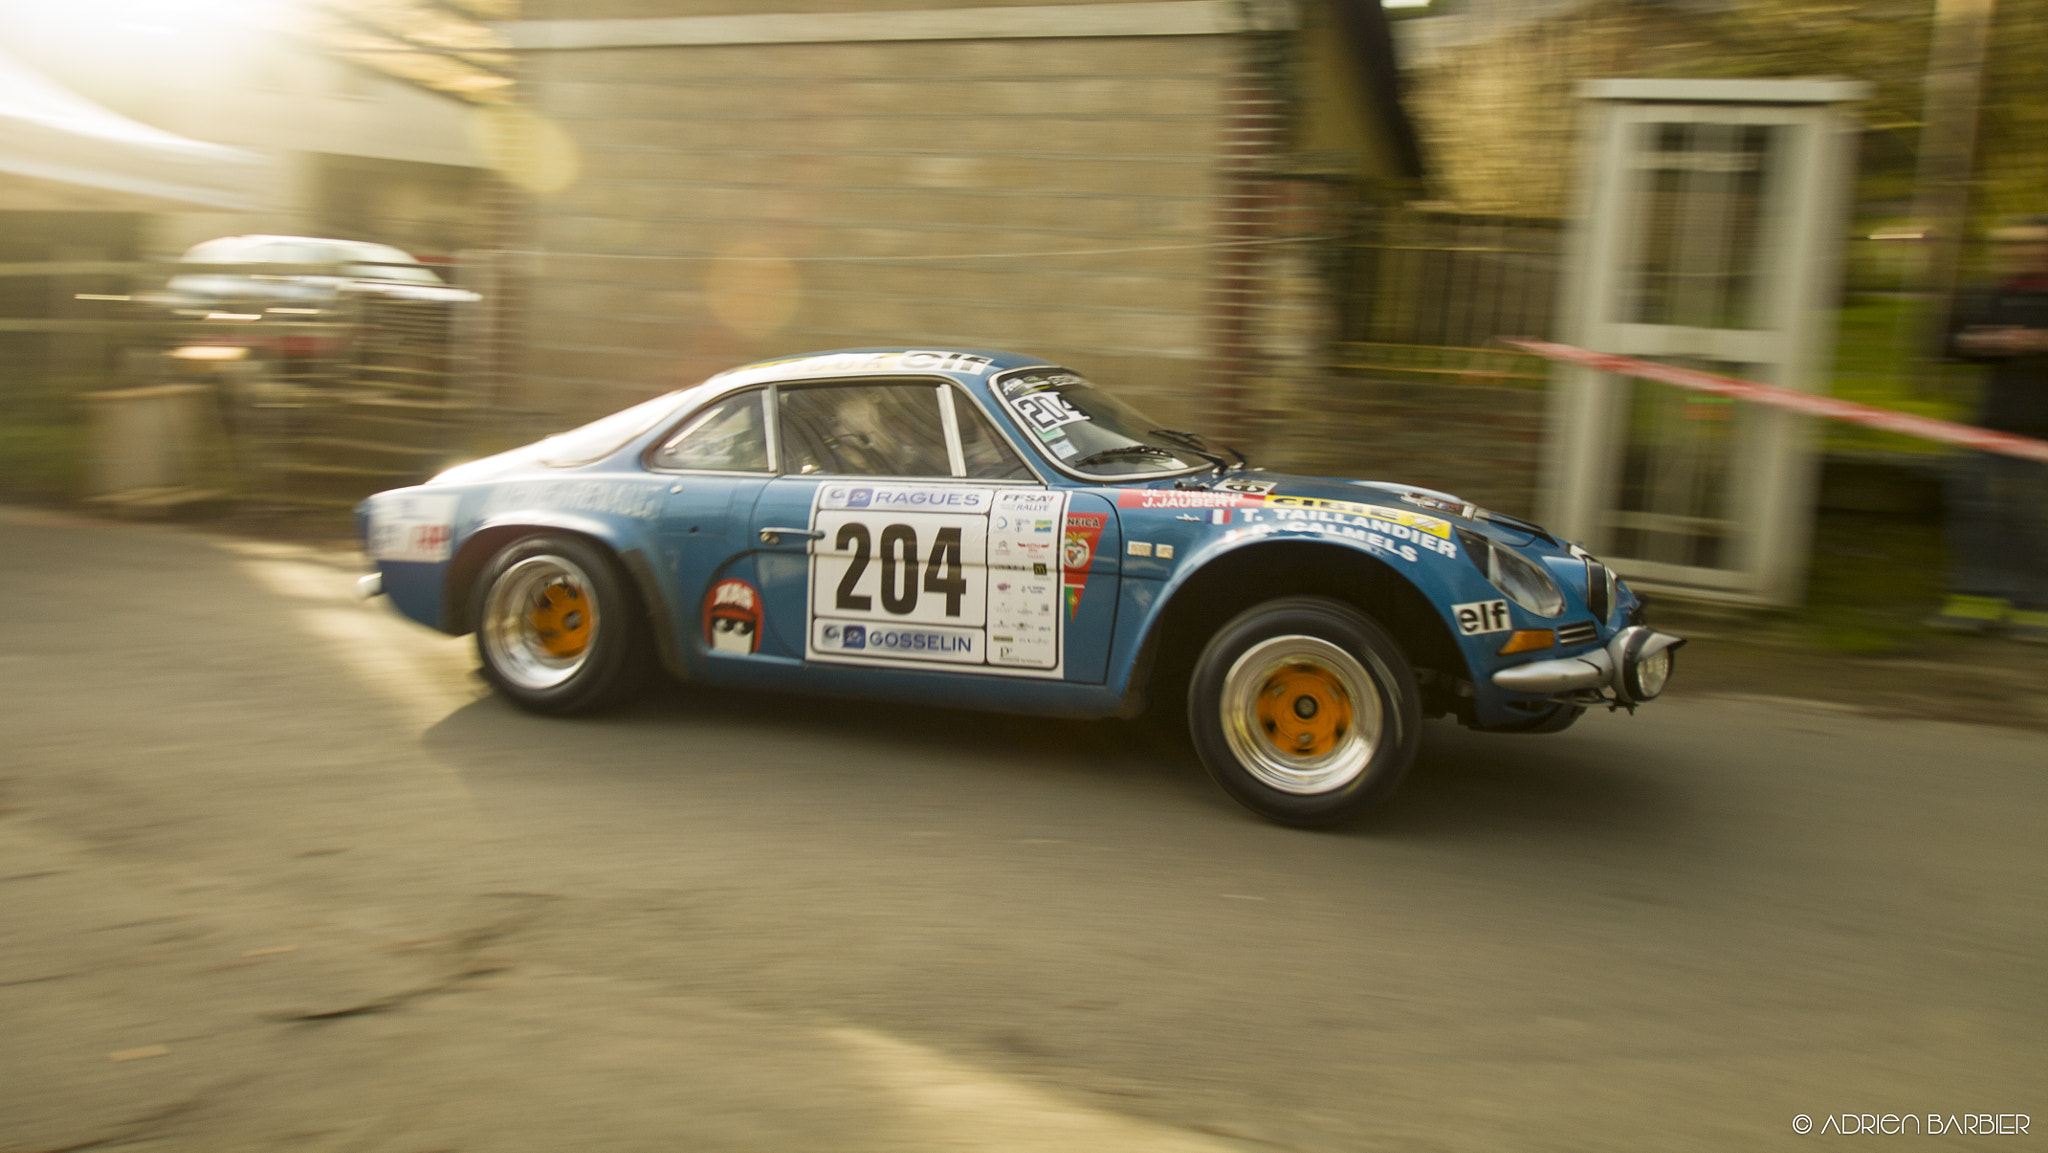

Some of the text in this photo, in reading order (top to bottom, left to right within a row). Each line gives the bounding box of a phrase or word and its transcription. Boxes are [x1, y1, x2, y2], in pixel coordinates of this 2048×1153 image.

[875, 491, 980, 506] RAGUES
[1003, 494, 1047, 502] FFSA
[1067, 517, 1100, 528] NFICA
[1240, 508, 1458, 559] T. TAILLANDIER
[1287, 521, 1418, 562] CALMELS
[835, 522, 967, 617] 204
[1459, 601, 1506, 632] elf
[869, 631, 972, 652] GOSSELIN
